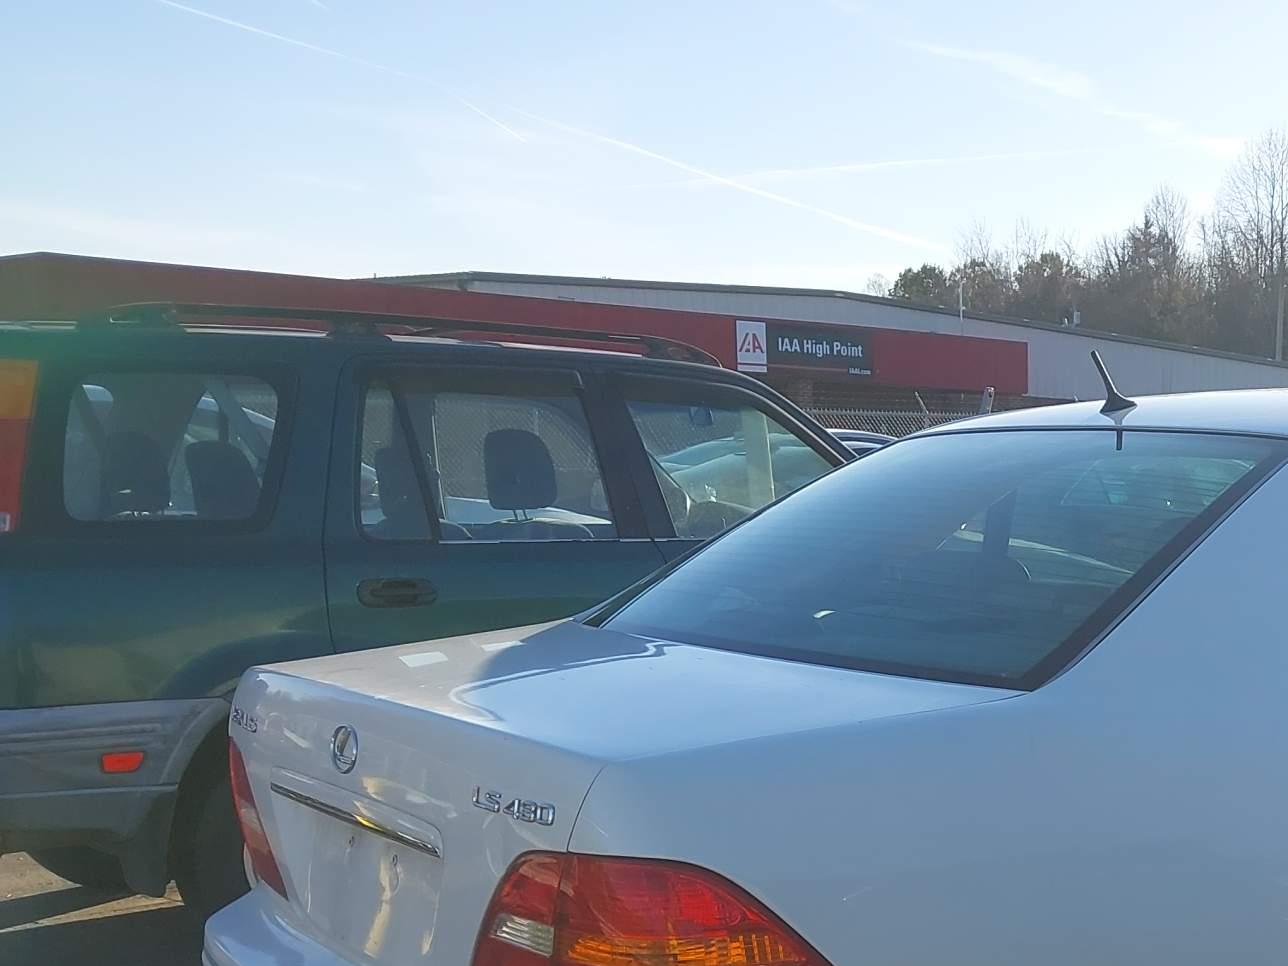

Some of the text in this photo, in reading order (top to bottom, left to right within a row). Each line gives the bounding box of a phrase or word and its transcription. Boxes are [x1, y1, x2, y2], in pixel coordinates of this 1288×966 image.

[778, 337, 863, 357] IAA High Point
[471, 784, 556, 827] LS 430
